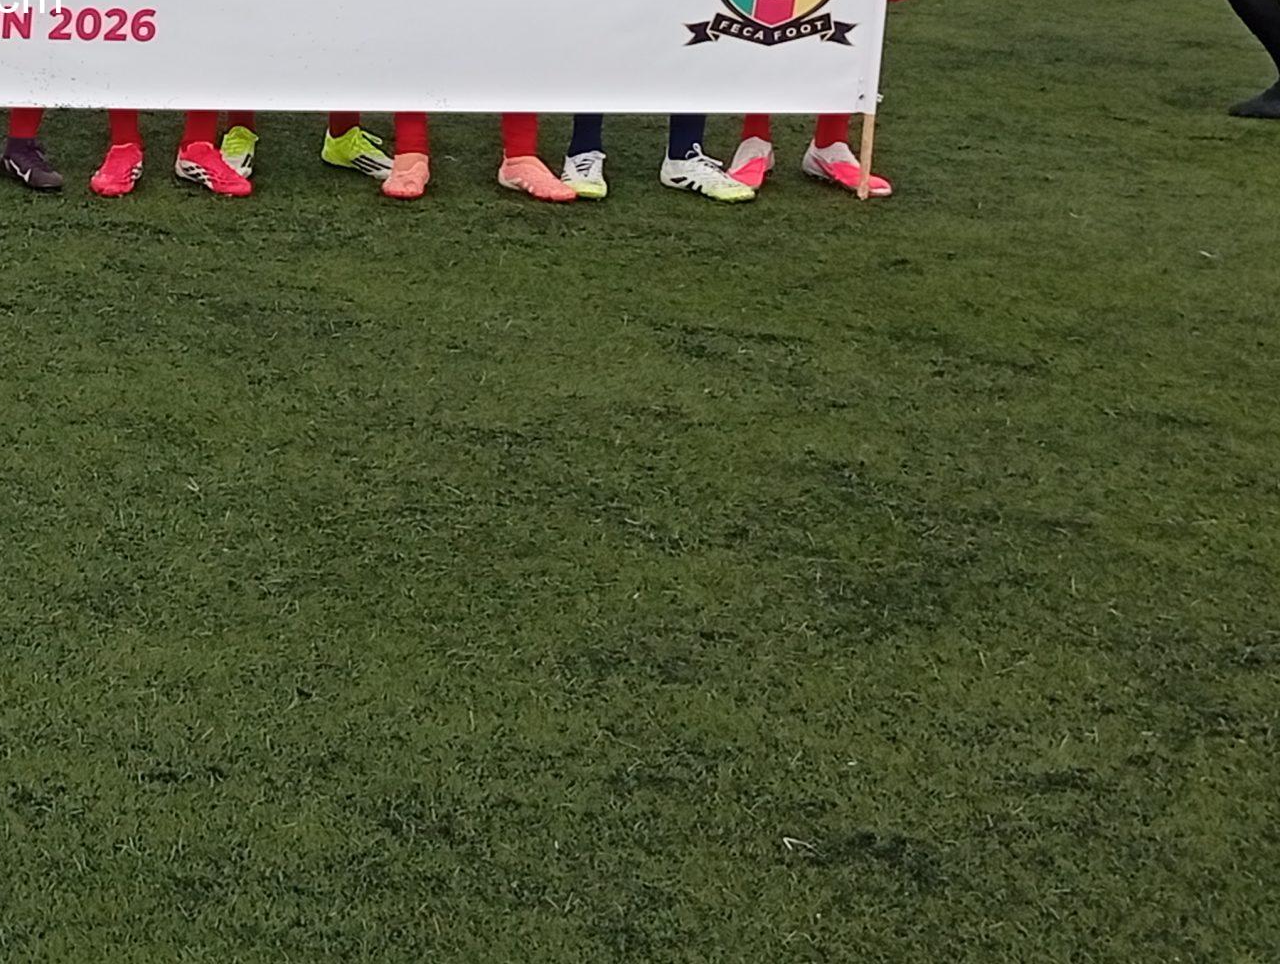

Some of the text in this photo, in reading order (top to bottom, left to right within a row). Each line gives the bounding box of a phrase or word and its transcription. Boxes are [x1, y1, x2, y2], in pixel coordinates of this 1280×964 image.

[48, 7, 157, 42] 2026
[719, 20, 825, 41] FECA FOOT
